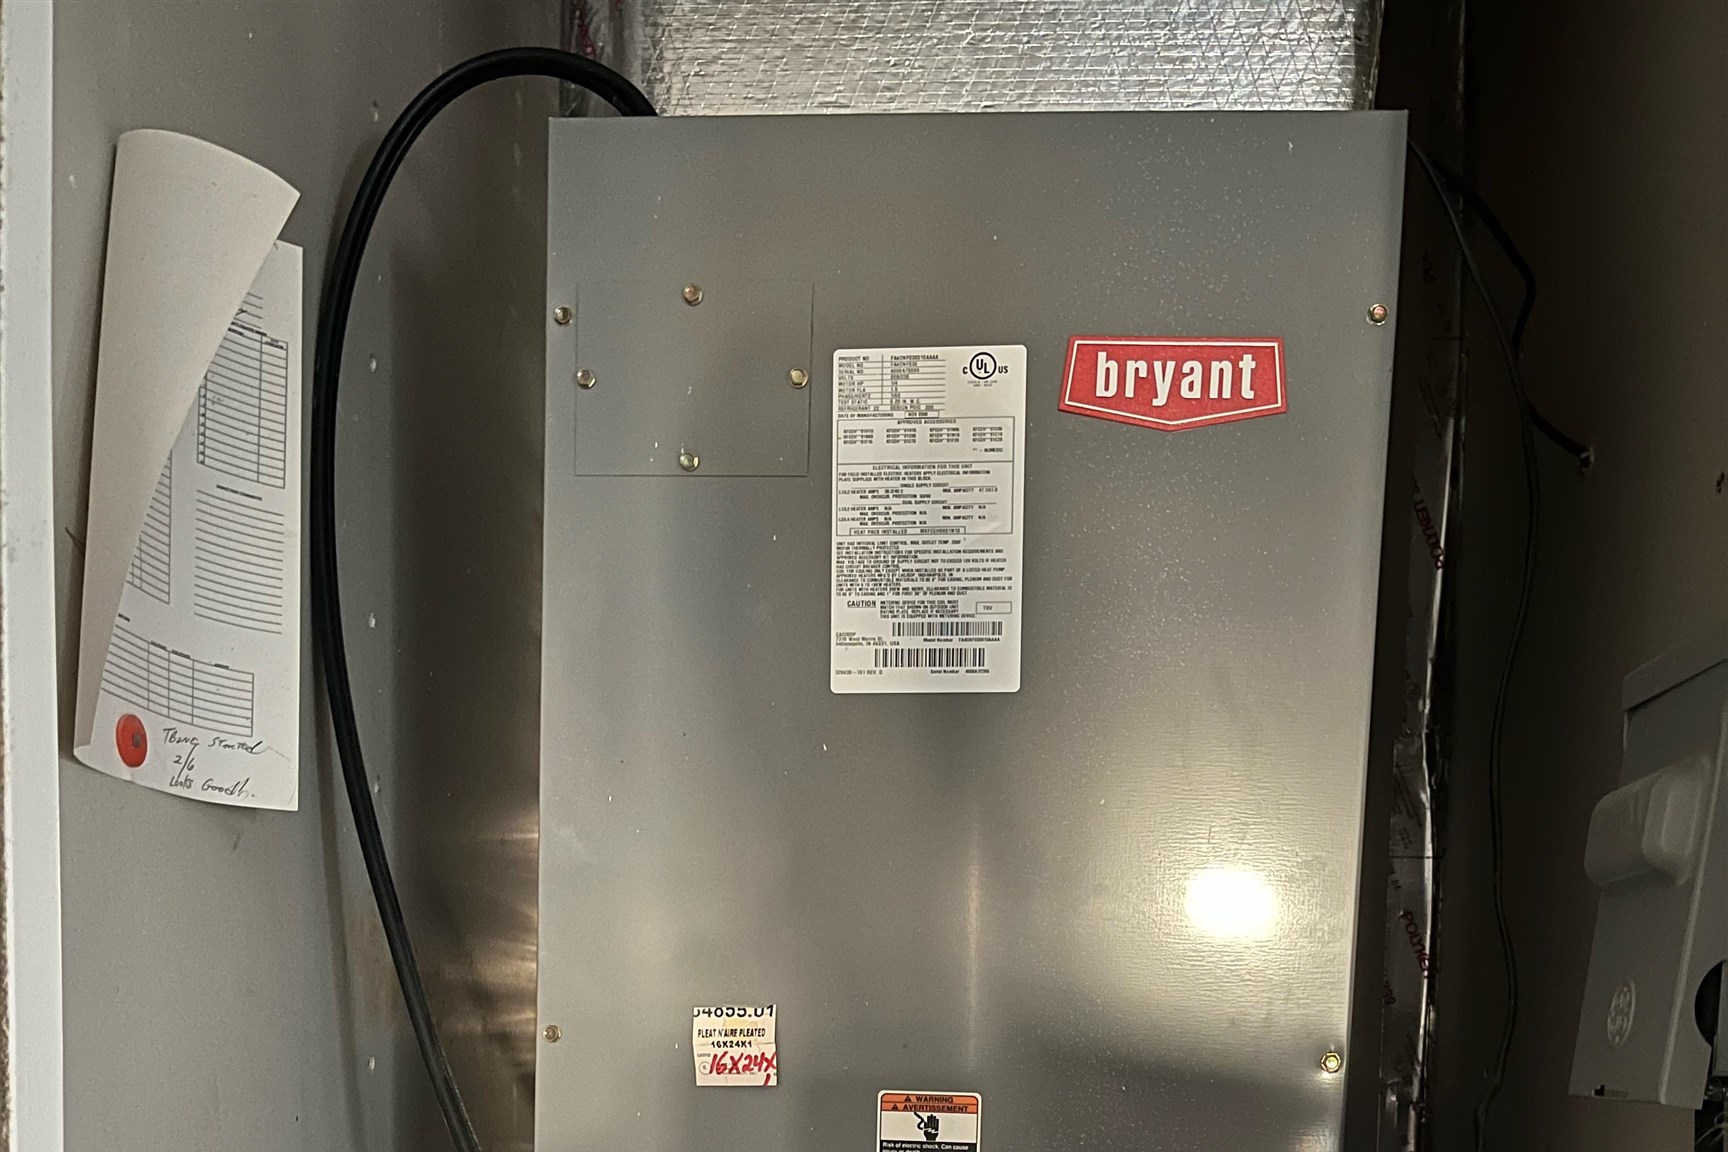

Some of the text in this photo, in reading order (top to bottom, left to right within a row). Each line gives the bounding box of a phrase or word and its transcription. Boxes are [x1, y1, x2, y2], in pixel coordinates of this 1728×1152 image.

[976, 359, 990, 374] UL
[1095, 351, 1256, 407] bryant
[698, 1029, 716, 1038] PLEAT
[739, 1028, 766, 1038] PLEATED
[711, 1040, 752, 1048] 16X24X1
[902, 1104, 969, 1112] AVERTISSEMENT
